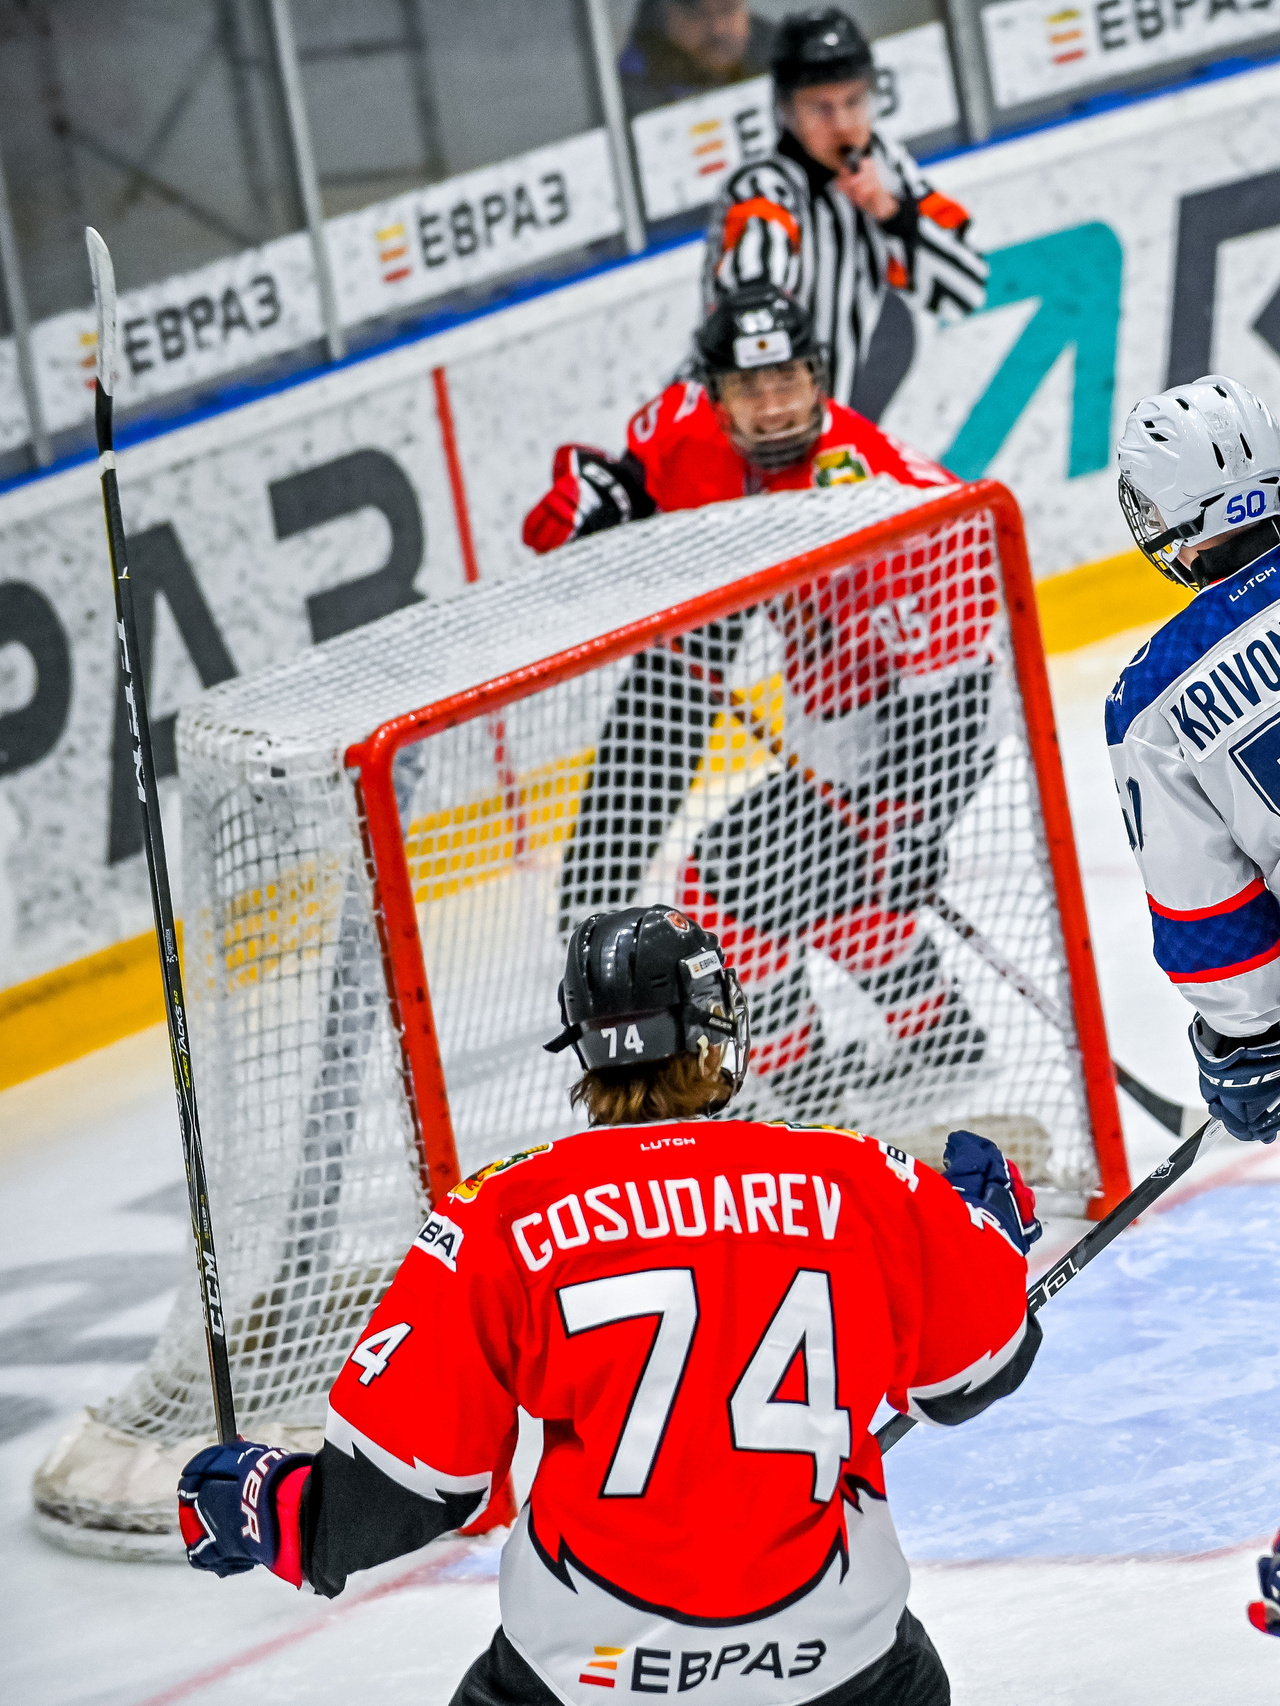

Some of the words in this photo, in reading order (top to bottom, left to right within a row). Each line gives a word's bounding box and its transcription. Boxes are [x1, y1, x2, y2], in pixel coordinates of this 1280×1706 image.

[417, 172, 571, 269] ЕВРАЗ
[122, 274, 283, 375] ЕВРАЗ
[1225, 489, 1268, 525] 50
[1227, 565, 1277, 603] LUTCH
[175, 1004, 189, 1055] TACKS
[600, 1023, 645, 1059] 74
[639, 1136, 696, 1152] LUTCH
[511, 1172, 841, 1272] GOSUDAREV
[202, 1248, 225, 1338] CCM
[350, 1321, 414, 1388] 4
[555, 1265, 852, 1503] 74
[630, 1638, 827, 1694] ЕВРАЗ
